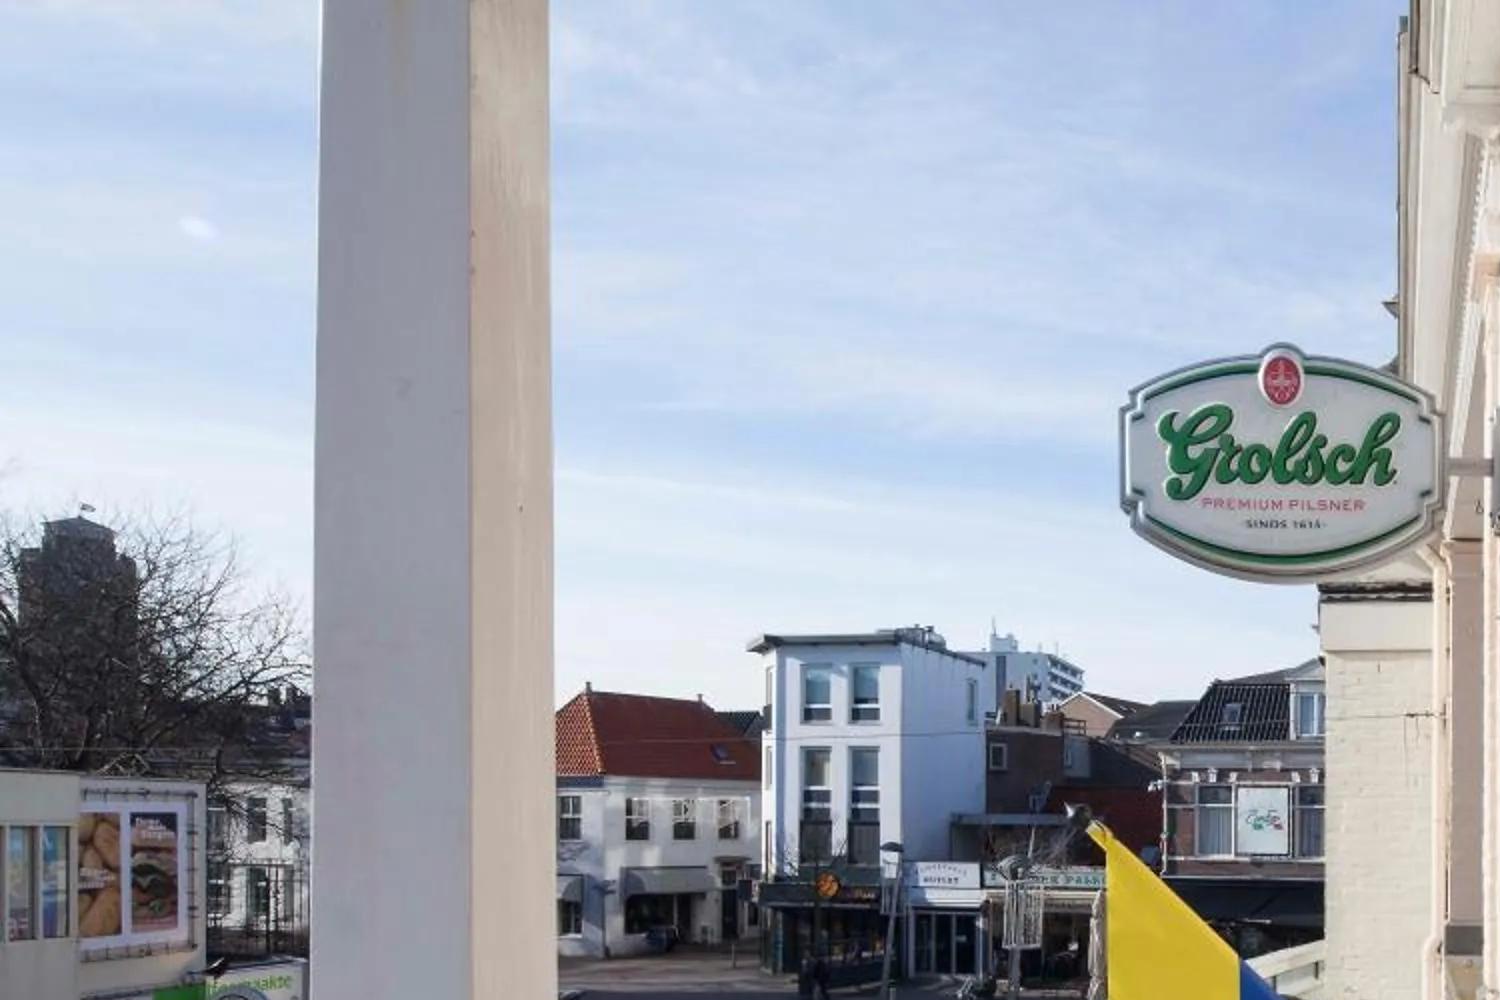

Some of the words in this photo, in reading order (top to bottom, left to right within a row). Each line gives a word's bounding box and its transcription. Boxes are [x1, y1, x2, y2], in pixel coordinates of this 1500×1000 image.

[1156, 403, 1402, 501] Grolsch
[1201, 498, 1283, 510] PREMIUM
[1288, 498, 1366, 511] PILSNER
